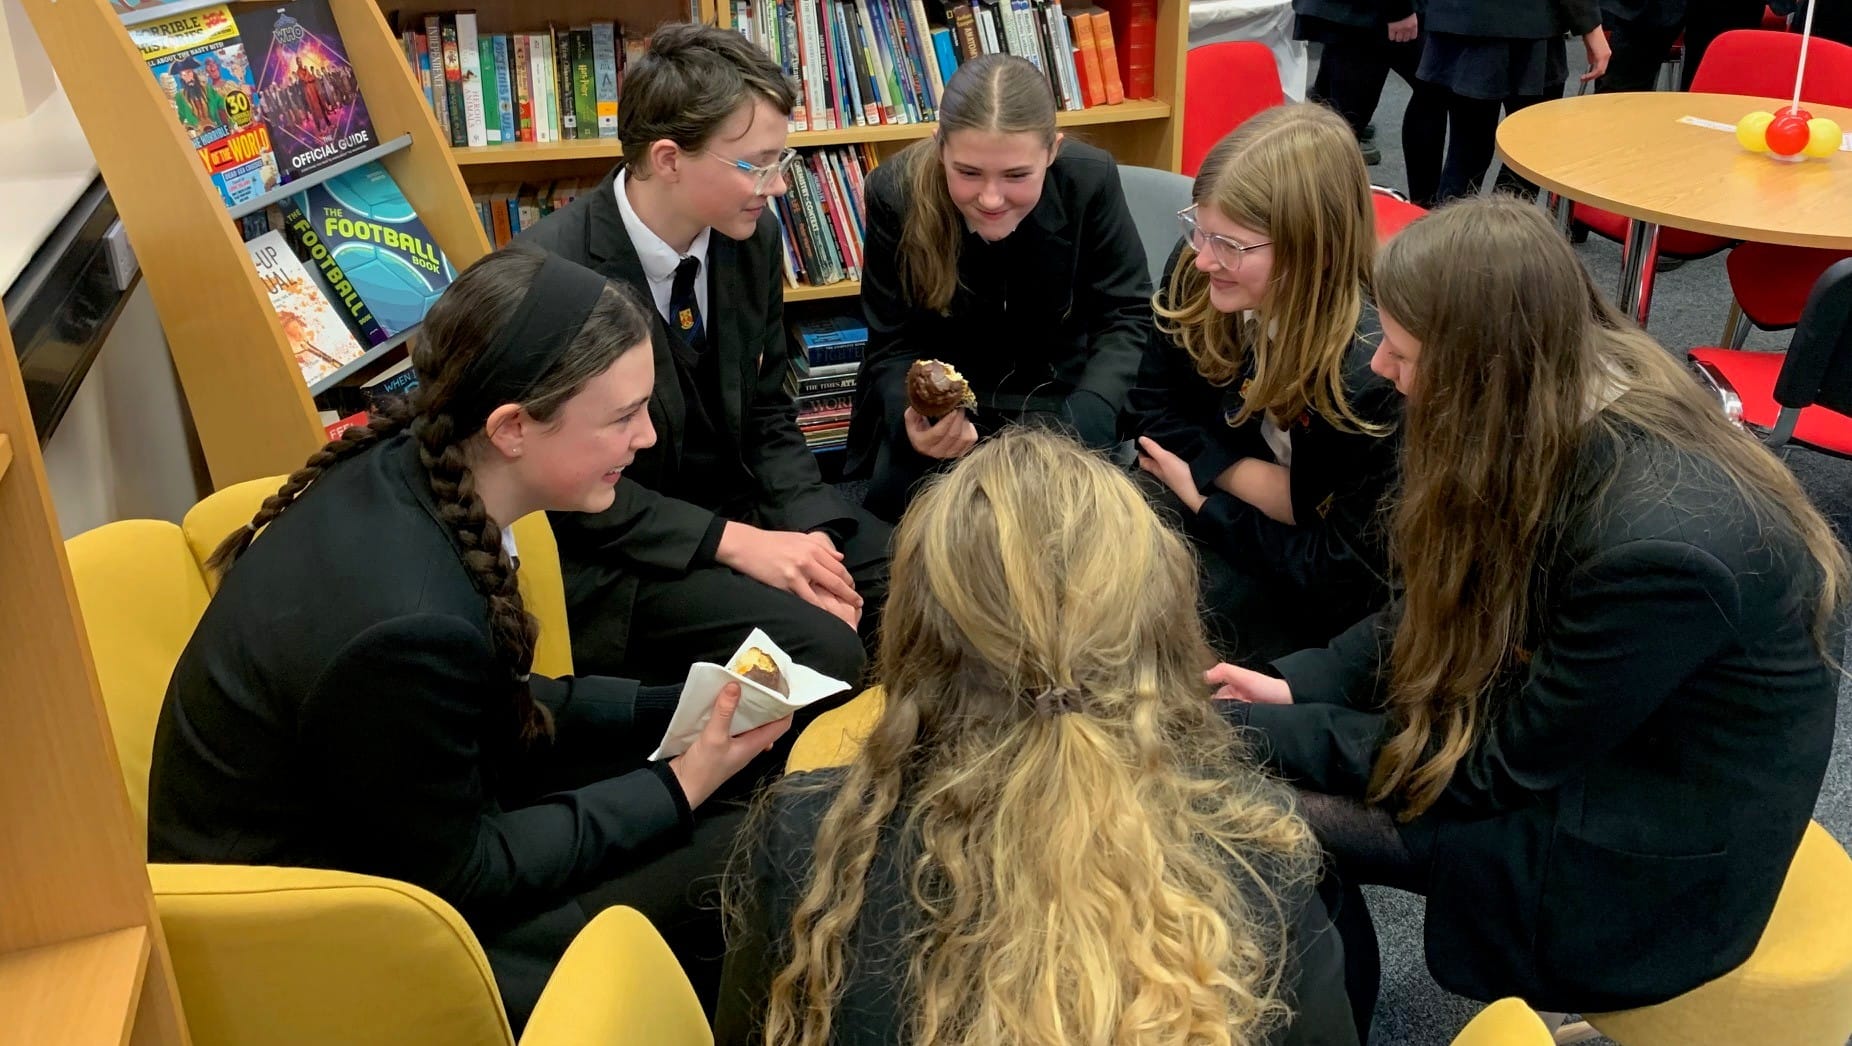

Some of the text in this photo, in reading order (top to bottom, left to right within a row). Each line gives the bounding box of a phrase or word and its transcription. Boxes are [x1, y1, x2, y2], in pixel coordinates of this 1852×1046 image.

[272, 25, 304, 43] WHO
[427, 25, 445, 87] INDEPENDENCE
[227, 93, 247, 114] 30
[227, 127, 270, 163] WORLD
[292, 143, 338, 168] OFFICIAL
[338, 130, 369, 150] GUIDE
[792, 159, 810, 198] CHEMISTRY
[804, 200, 819, 231] CONTEXT
[287, 208, 302, 222] THE
[323, 208, 343, 218] THE
[324, 217, 440, 265] FOOTBALL
[293, 219, 364, 317] FOOTBALL
[412, 255, 441, 274] BOOK
[384, 373, 410, 393] WHEN
[840, 378, 857, 388] ATL
